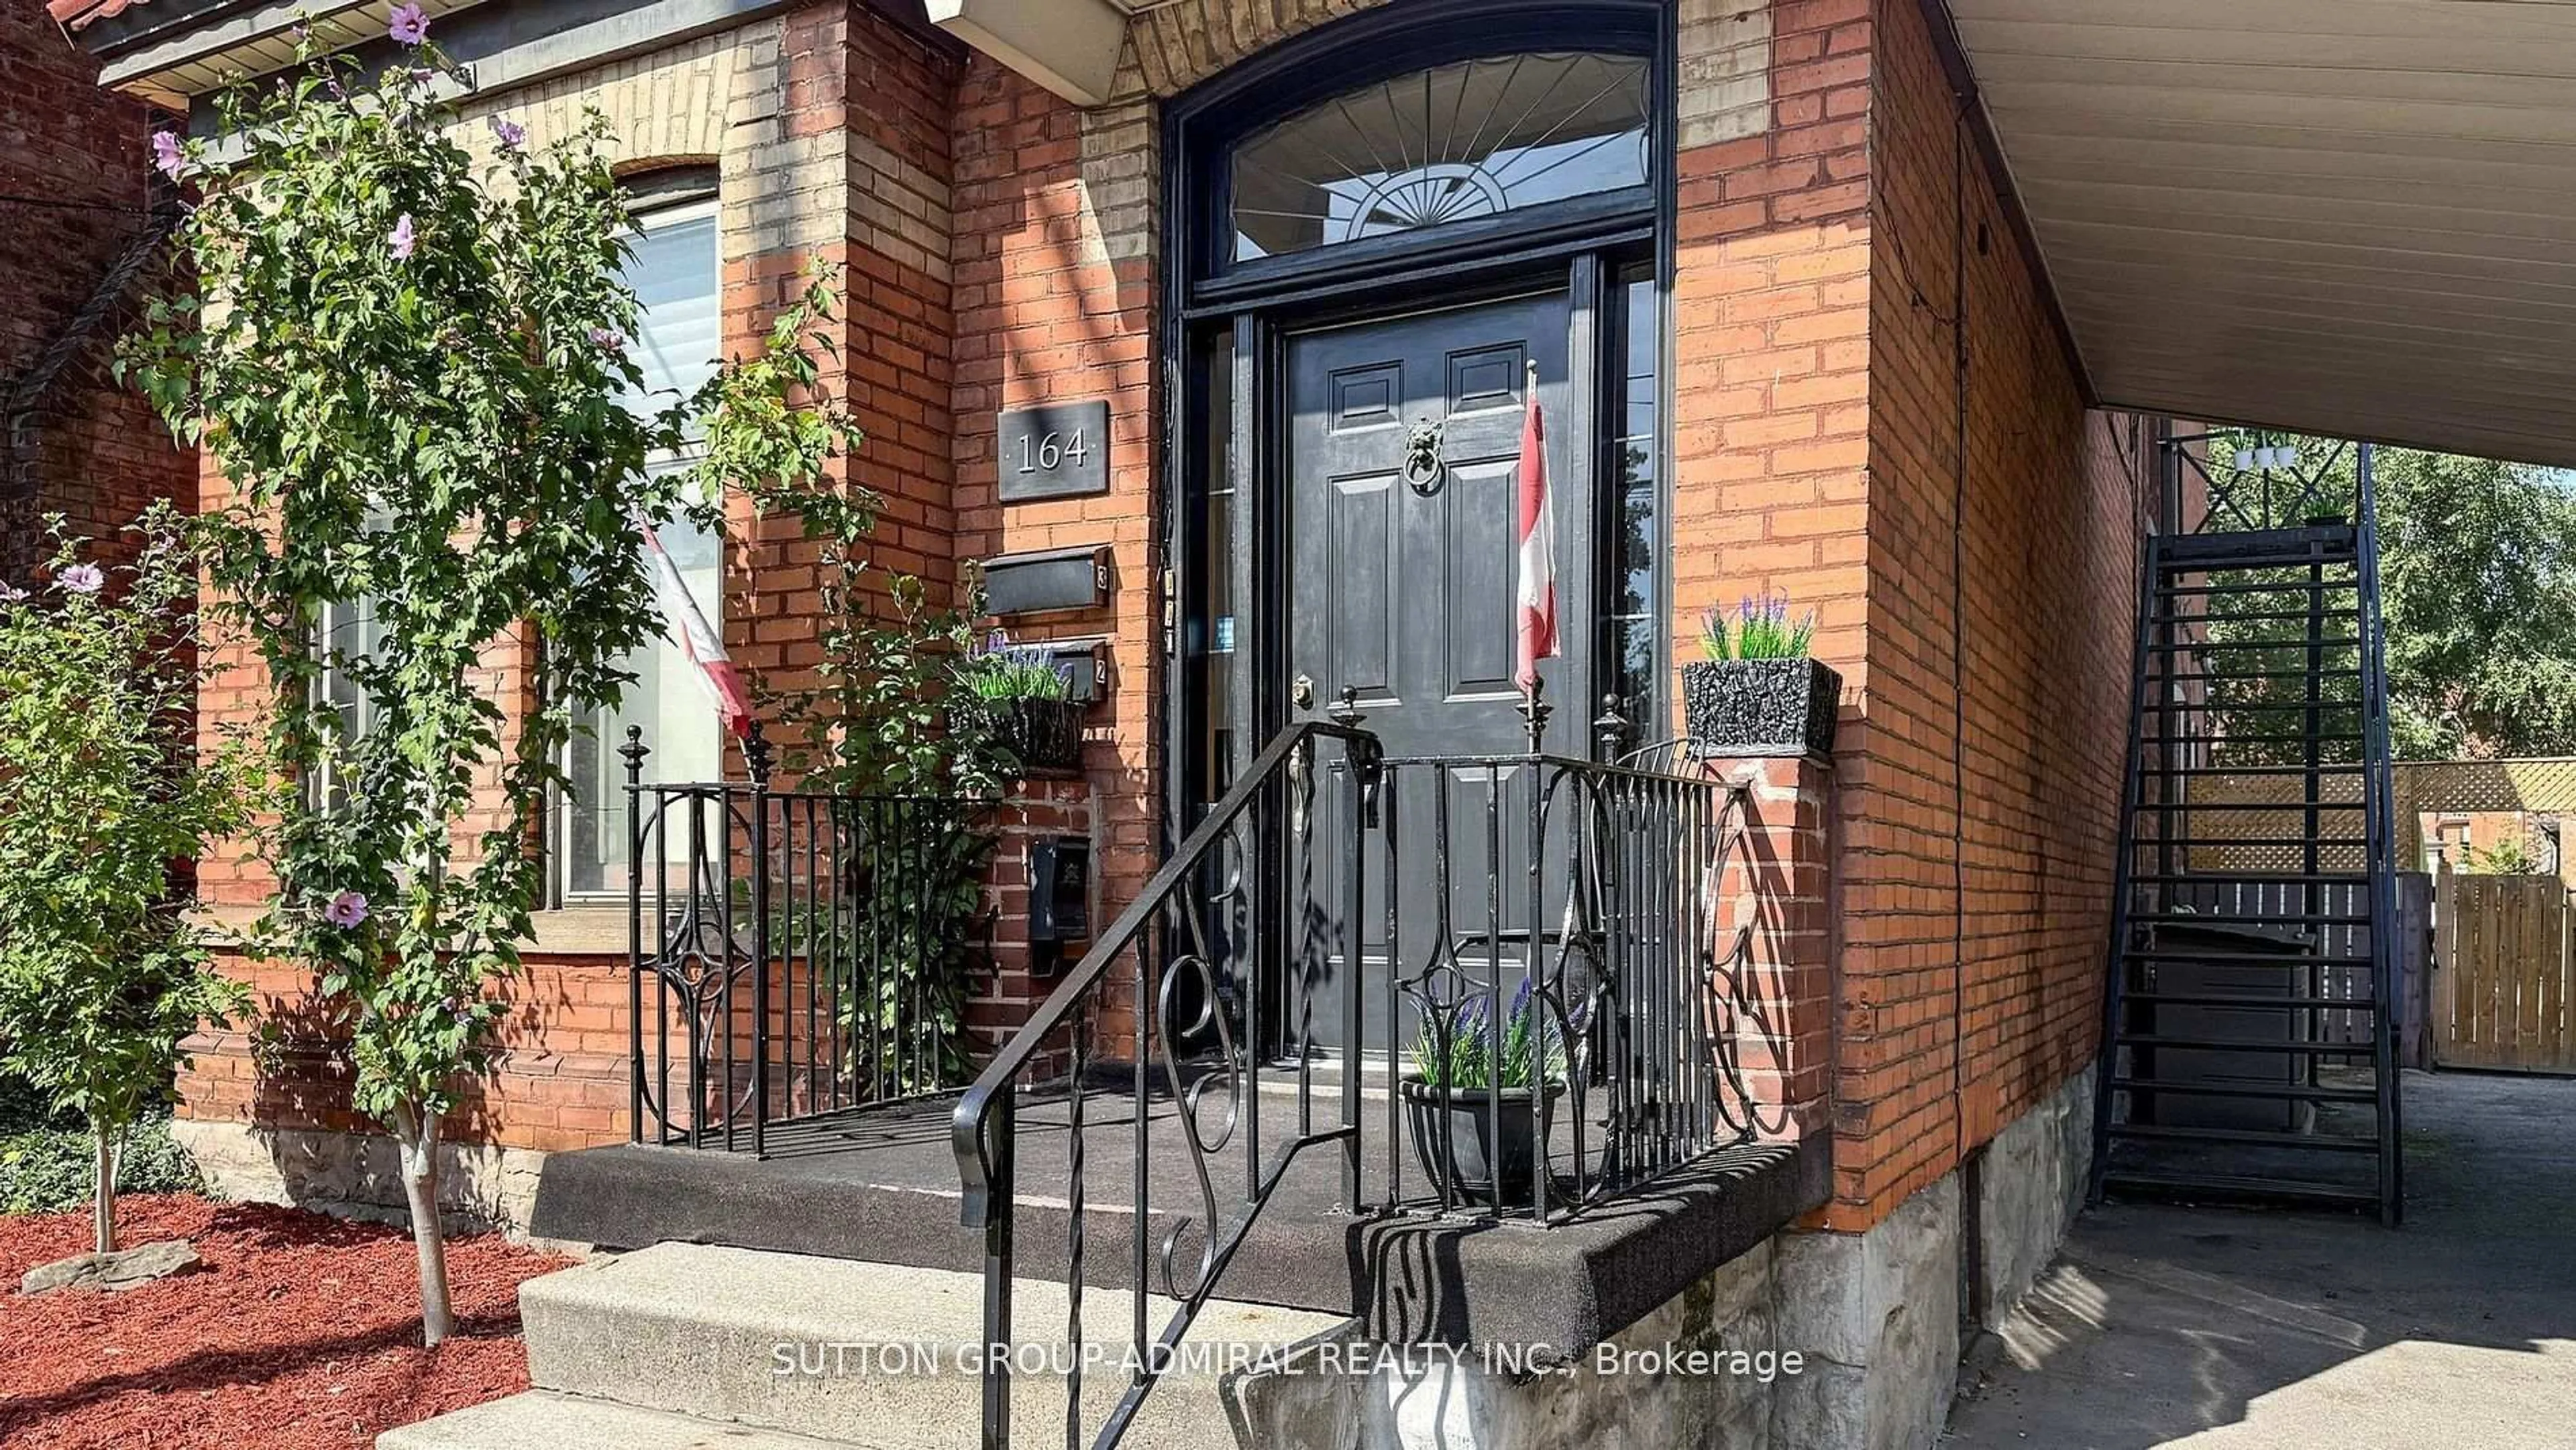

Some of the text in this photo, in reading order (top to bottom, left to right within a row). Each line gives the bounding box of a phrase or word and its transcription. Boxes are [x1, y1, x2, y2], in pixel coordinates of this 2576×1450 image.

[1019, 427, 1087, 474] 164
[1099, 567, 1106, 587] 3
[1097, 661, 1105, 682] 2
